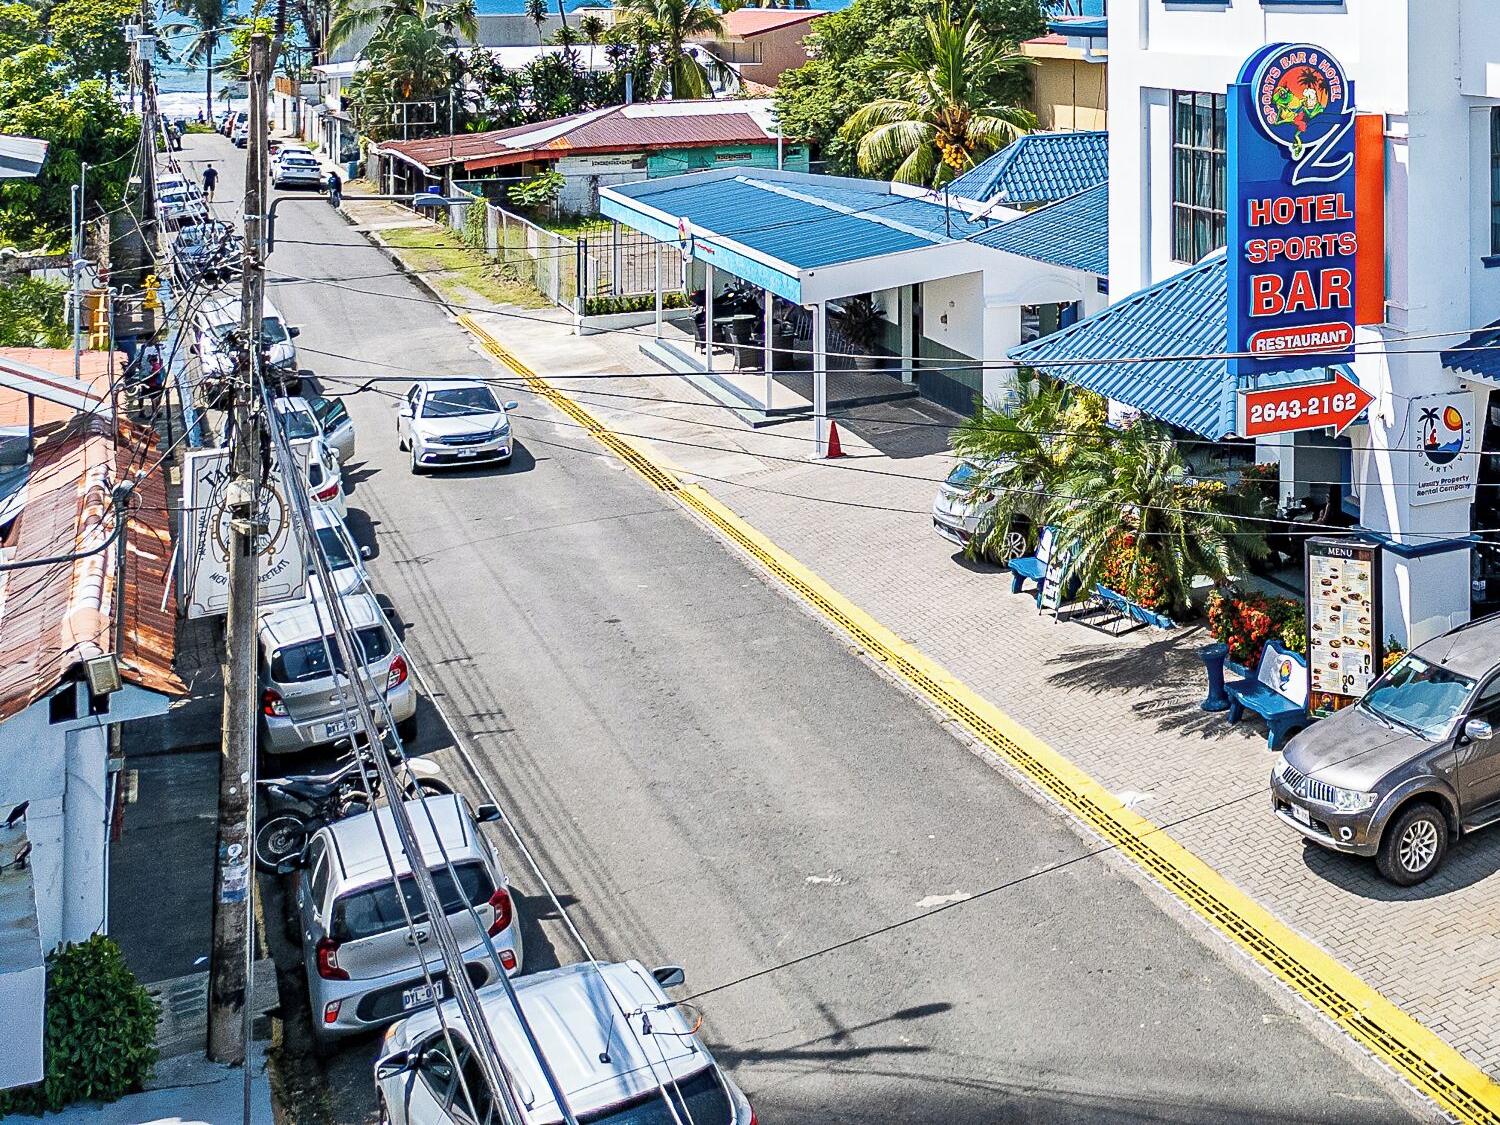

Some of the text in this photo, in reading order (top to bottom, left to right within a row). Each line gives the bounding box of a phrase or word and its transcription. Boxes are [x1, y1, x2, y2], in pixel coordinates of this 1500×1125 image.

[1262, 52, 1342, 124] SPORTS BAR & HOTEL
[1248, 193, 1353, 228] HOTEL
[1245, 231, 1357, 264] SPORTS
[1249, 268, 1352, 318] BAR
[1256, 327, 1348, 352] RESTAURANT
[1250, 392, 1357, 424] 2643-2162
[1424, 461, 1454, 473] PARTY
[1416, 482, 1471, 496] Rental Company
[1418, 474, 1470, 489] Luxury Property
[1328, 547, 1352, 557] MENU
[404, 984, 442, 1004] DYL-01
